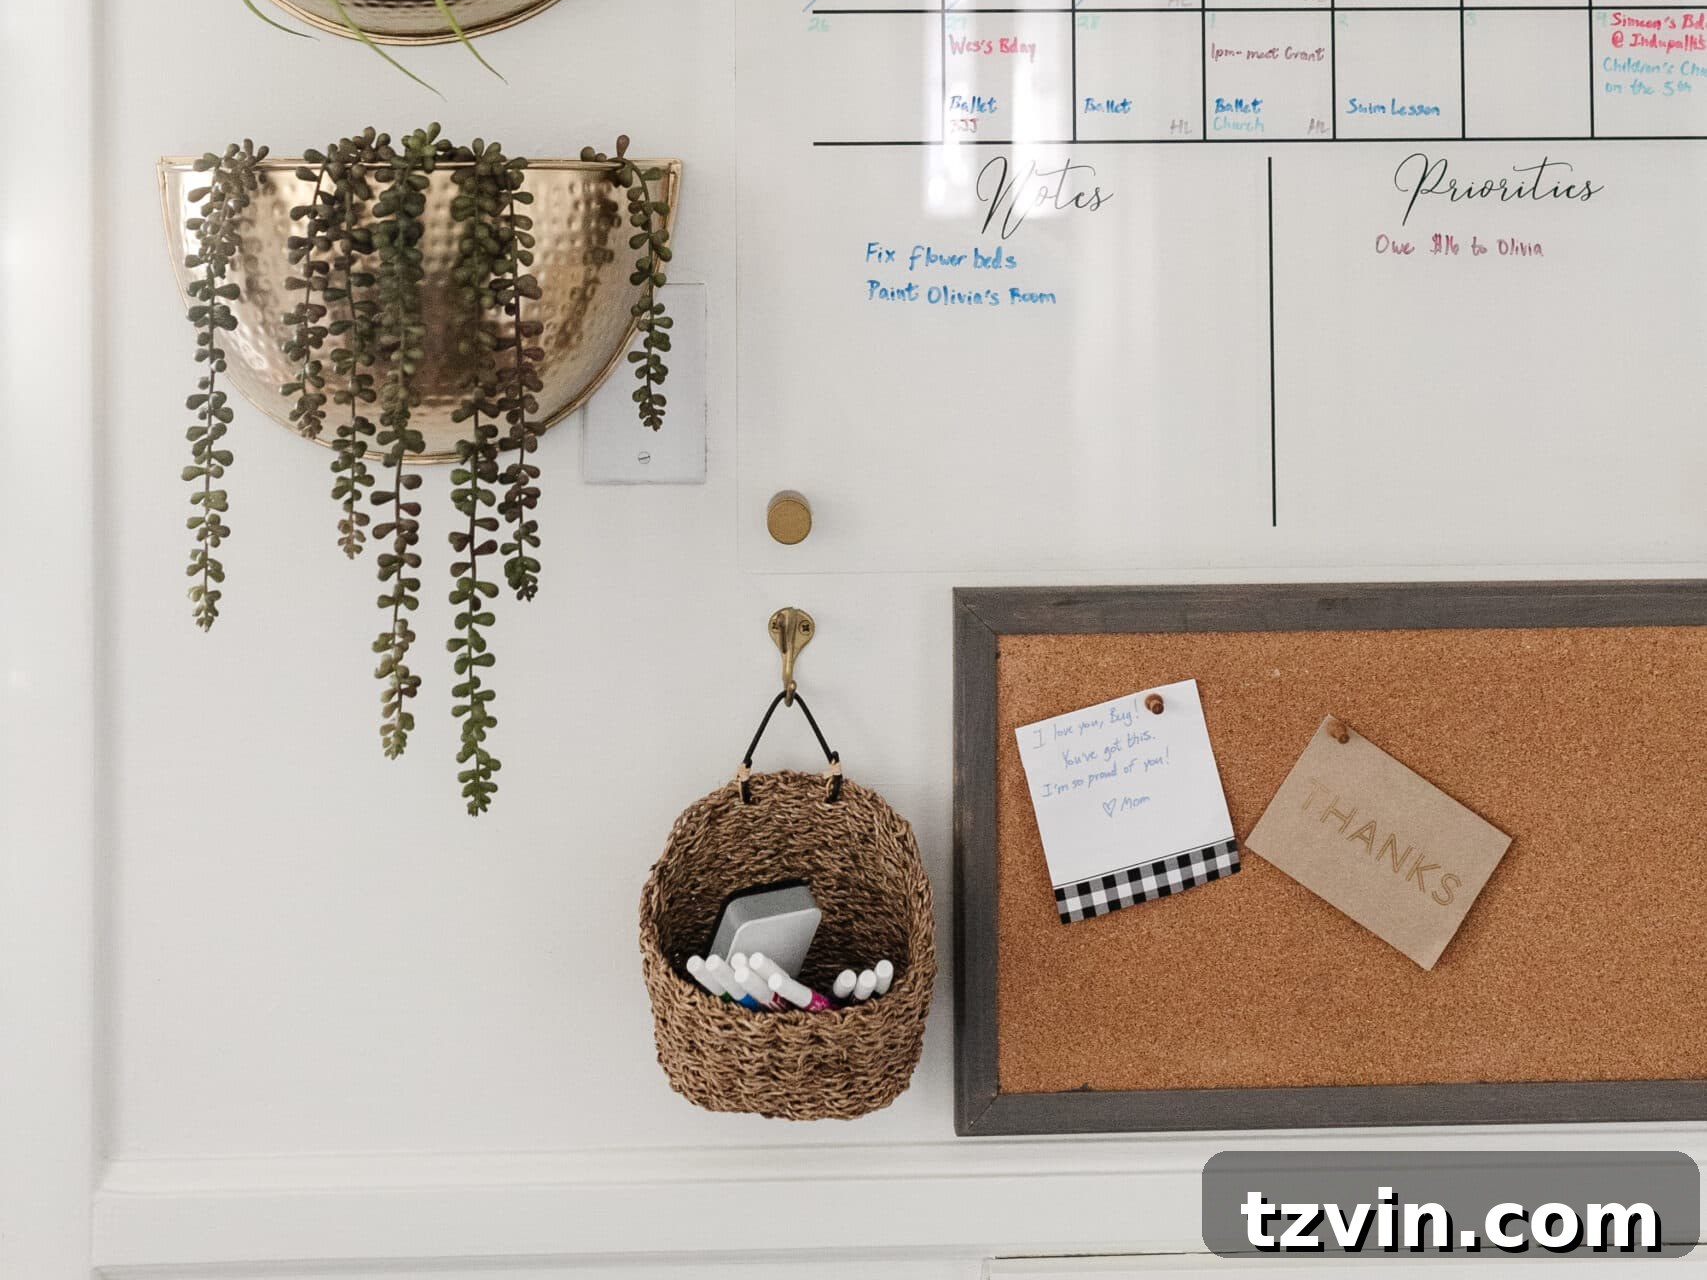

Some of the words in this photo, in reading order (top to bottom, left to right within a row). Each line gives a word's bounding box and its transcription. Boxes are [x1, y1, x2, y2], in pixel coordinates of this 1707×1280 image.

[1682, 13, 1707, 30] Bd
[949, 34, 993, 56] Wes's
[999, 37, 1036, 64] Bday
[1611, 30, 1624, 49] @
[1284, 45, 1325, 61] Grant
[1605, 81, 1623, 94] on
[1630, 78, 1656, 96] the
[949, 95, 998, 114] Ballet
[1084, 97, 1133, 114] Ballet
[1215, 97, 1264, 114] Ballet
[1346, 97, 1386, 115] Swim
[1390, 97, 1440, 116] Lesson
[1213, 116, 1265, 133] Church
[976, 156, 1114, 240] Notes
[1394, 153, 1604, 226] Priorities
[1375, 233, 1415, 255] Owe
[1471, 235, 1488, 255] to
[1498, 237, 1544, 257] Olivia
[865, 242, 896, 264] Fix
[909, 245, 967, 271] flower
[973, 246, 1018, 270] beds
[866, 279, 919, 302] Paint
[927, 284, 1000, 306] Olivia's
[1008, 287, 1057, 305] Room
[1032, 729, 1046, 749] I
[1053, 723, 1073, 741] love
[1062, 748, 1097, 769] You've
[1104, 740, 1122, 762] got
[1072, 777, 1085, 789] so
[1088, 768, 1118, 789] proud
[1123, 758, 1138, 776] of
[1120, 795, 1151, 812] Mom
[1302, 777, 1462, 906] THANKS
